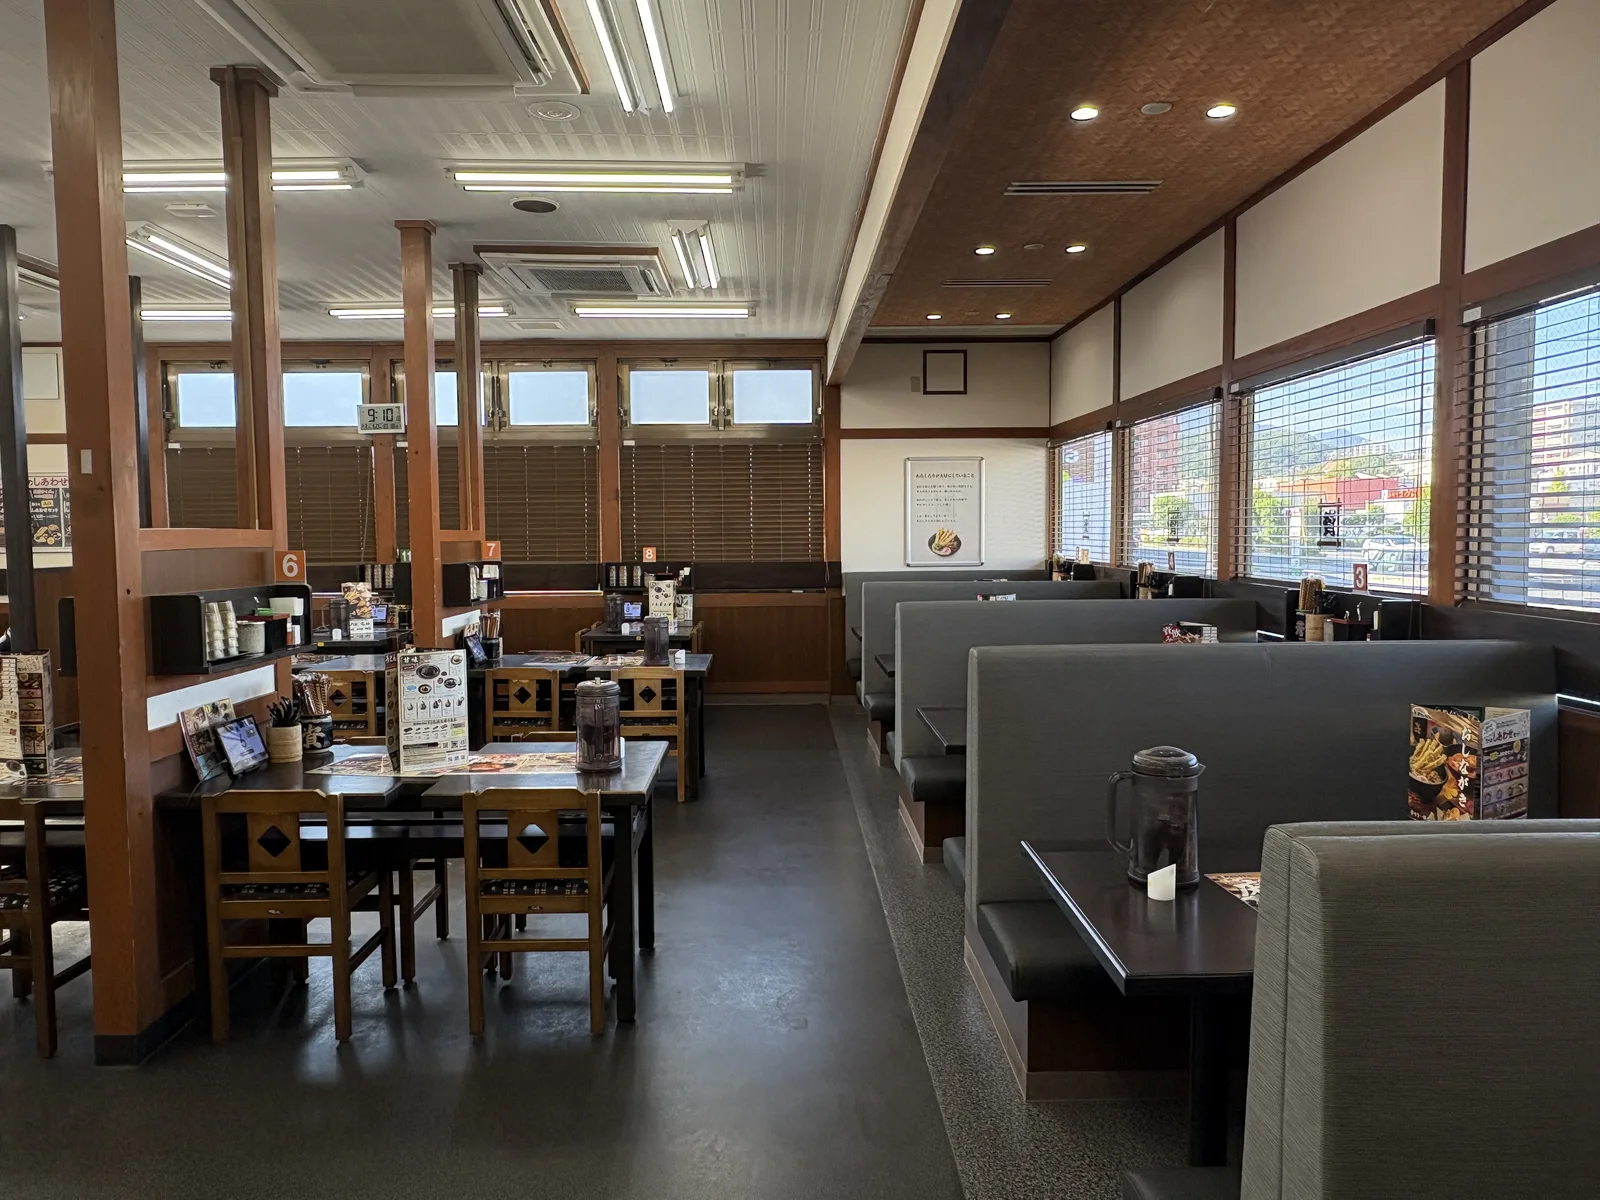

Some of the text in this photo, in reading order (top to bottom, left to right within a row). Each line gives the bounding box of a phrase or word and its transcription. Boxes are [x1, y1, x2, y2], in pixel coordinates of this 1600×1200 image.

[367, 408, 394, 423] 9:10
[401, 550, 412, 562] 11
[486, 543, 496, 557] 7
[645, 548, 653, 560] 8
[282, 553, 299, 578] 6
[1355, 566, 1364, 589] 3
[1458, 726, 1472, 808] おしながき
